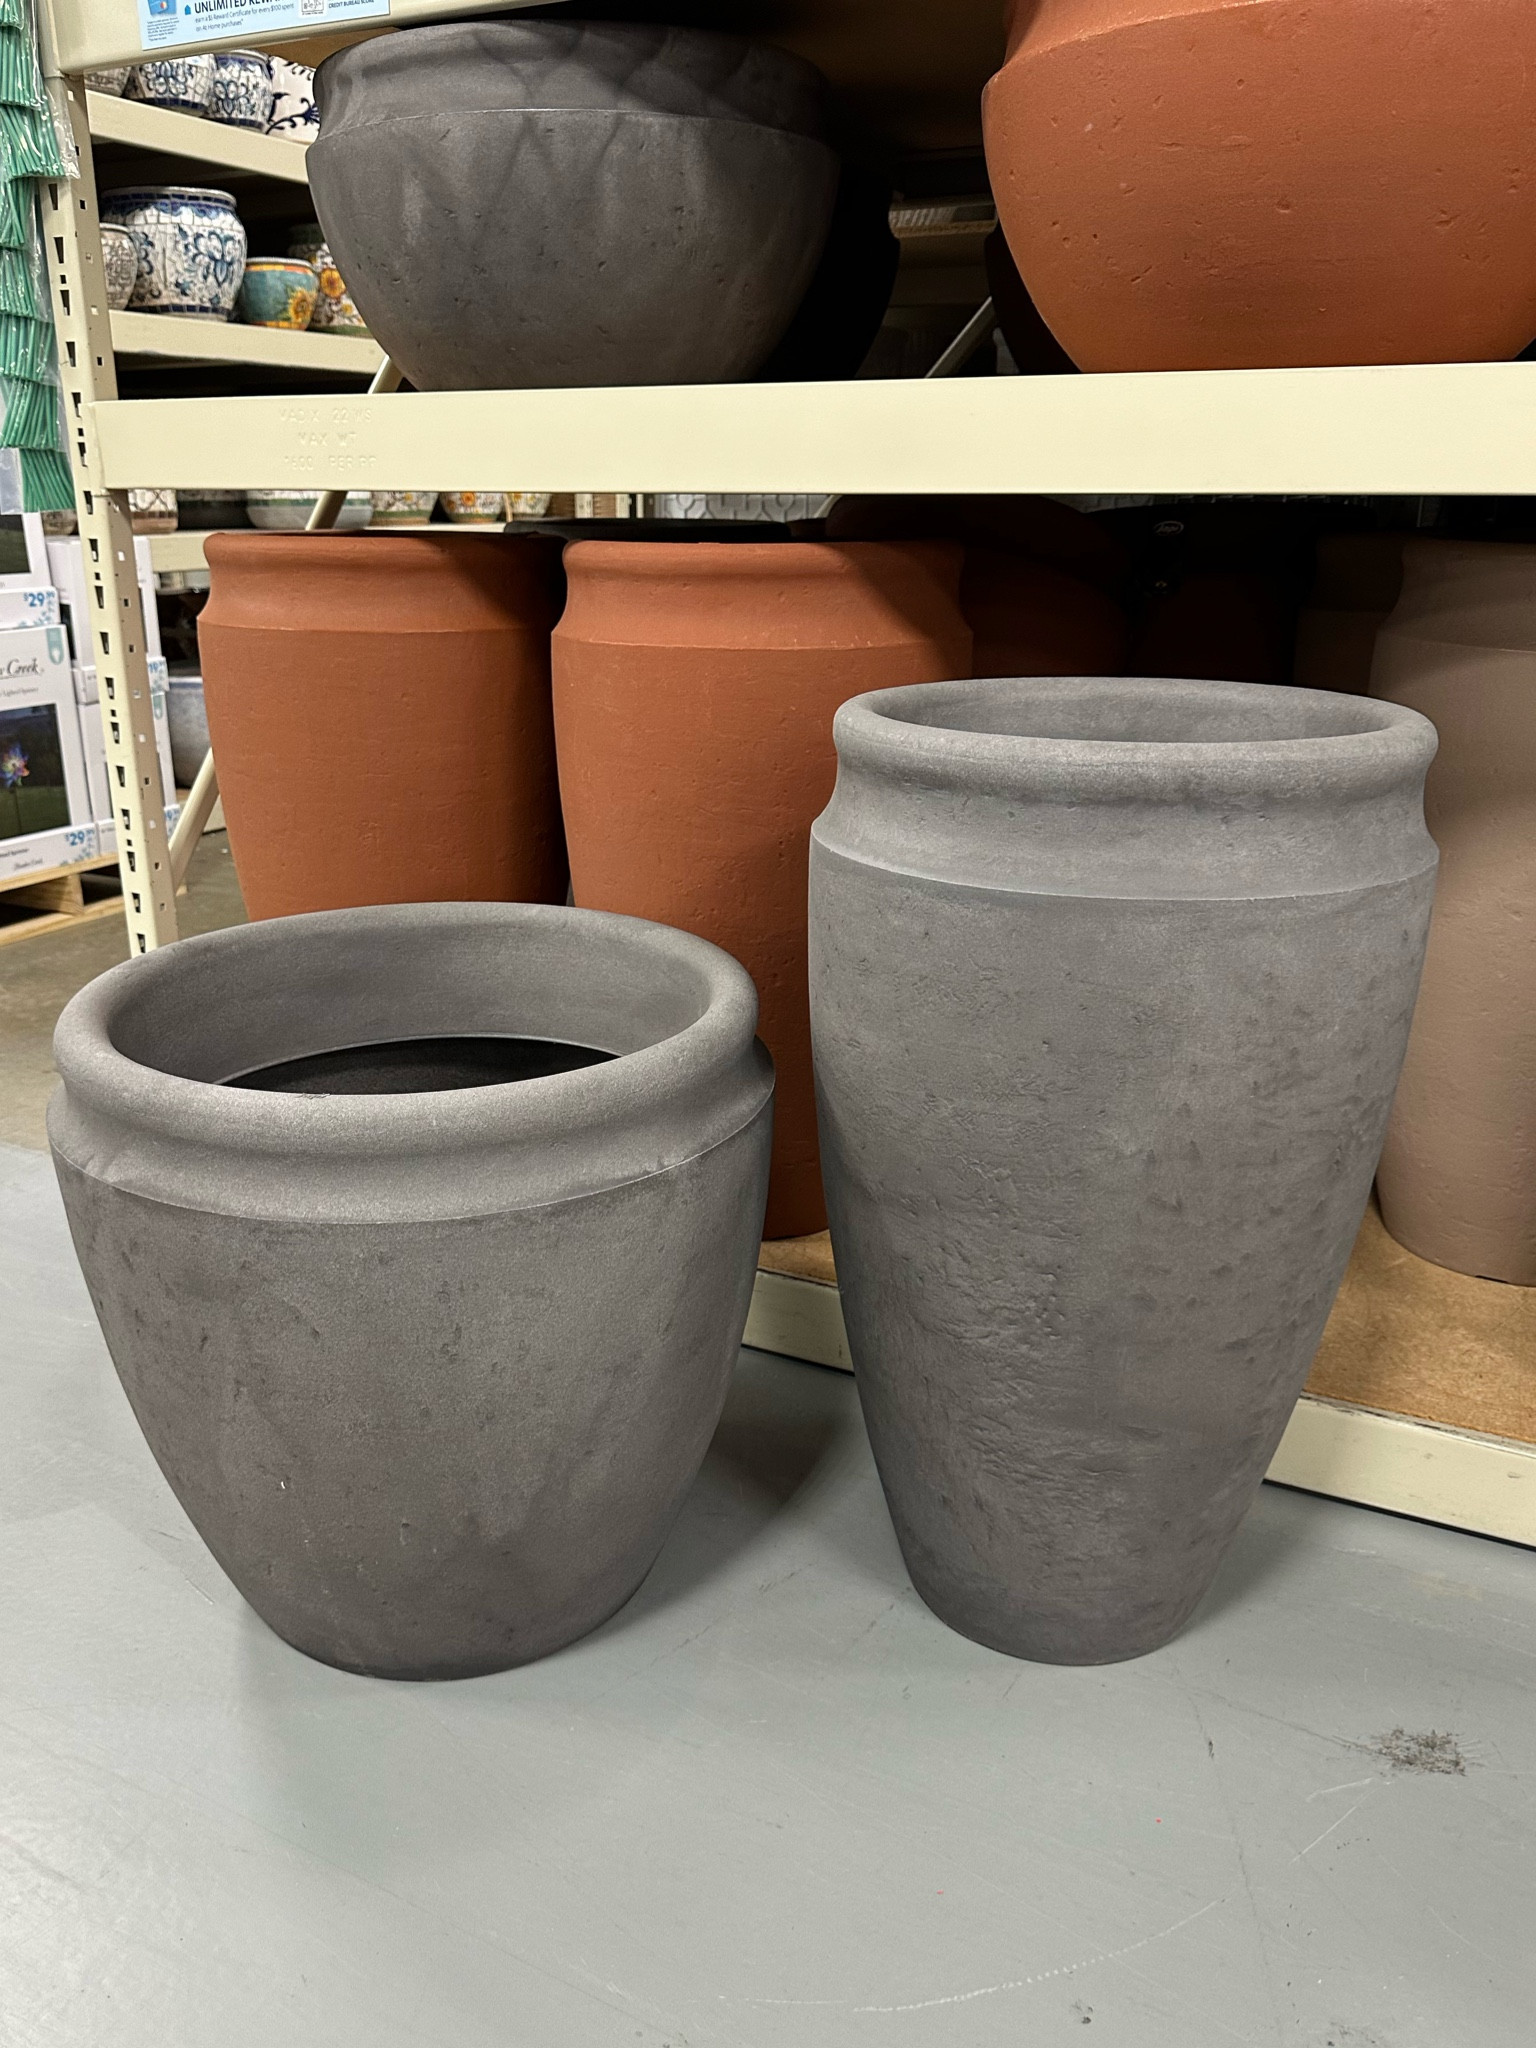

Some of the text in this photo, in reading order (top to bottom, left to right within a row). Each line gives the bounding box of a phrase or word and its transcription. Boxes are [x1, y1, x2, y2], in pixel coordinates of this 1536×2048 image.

[194, 0, 246, 14] UNLIMITED
[213, 12, 229, 20] Reward
[229, 9, 251, 18] Certificate
[270, 4, 281, 12] $100
[328, 1, 343, 9] CREDIT
[7, 657, 39, 676] Creek
